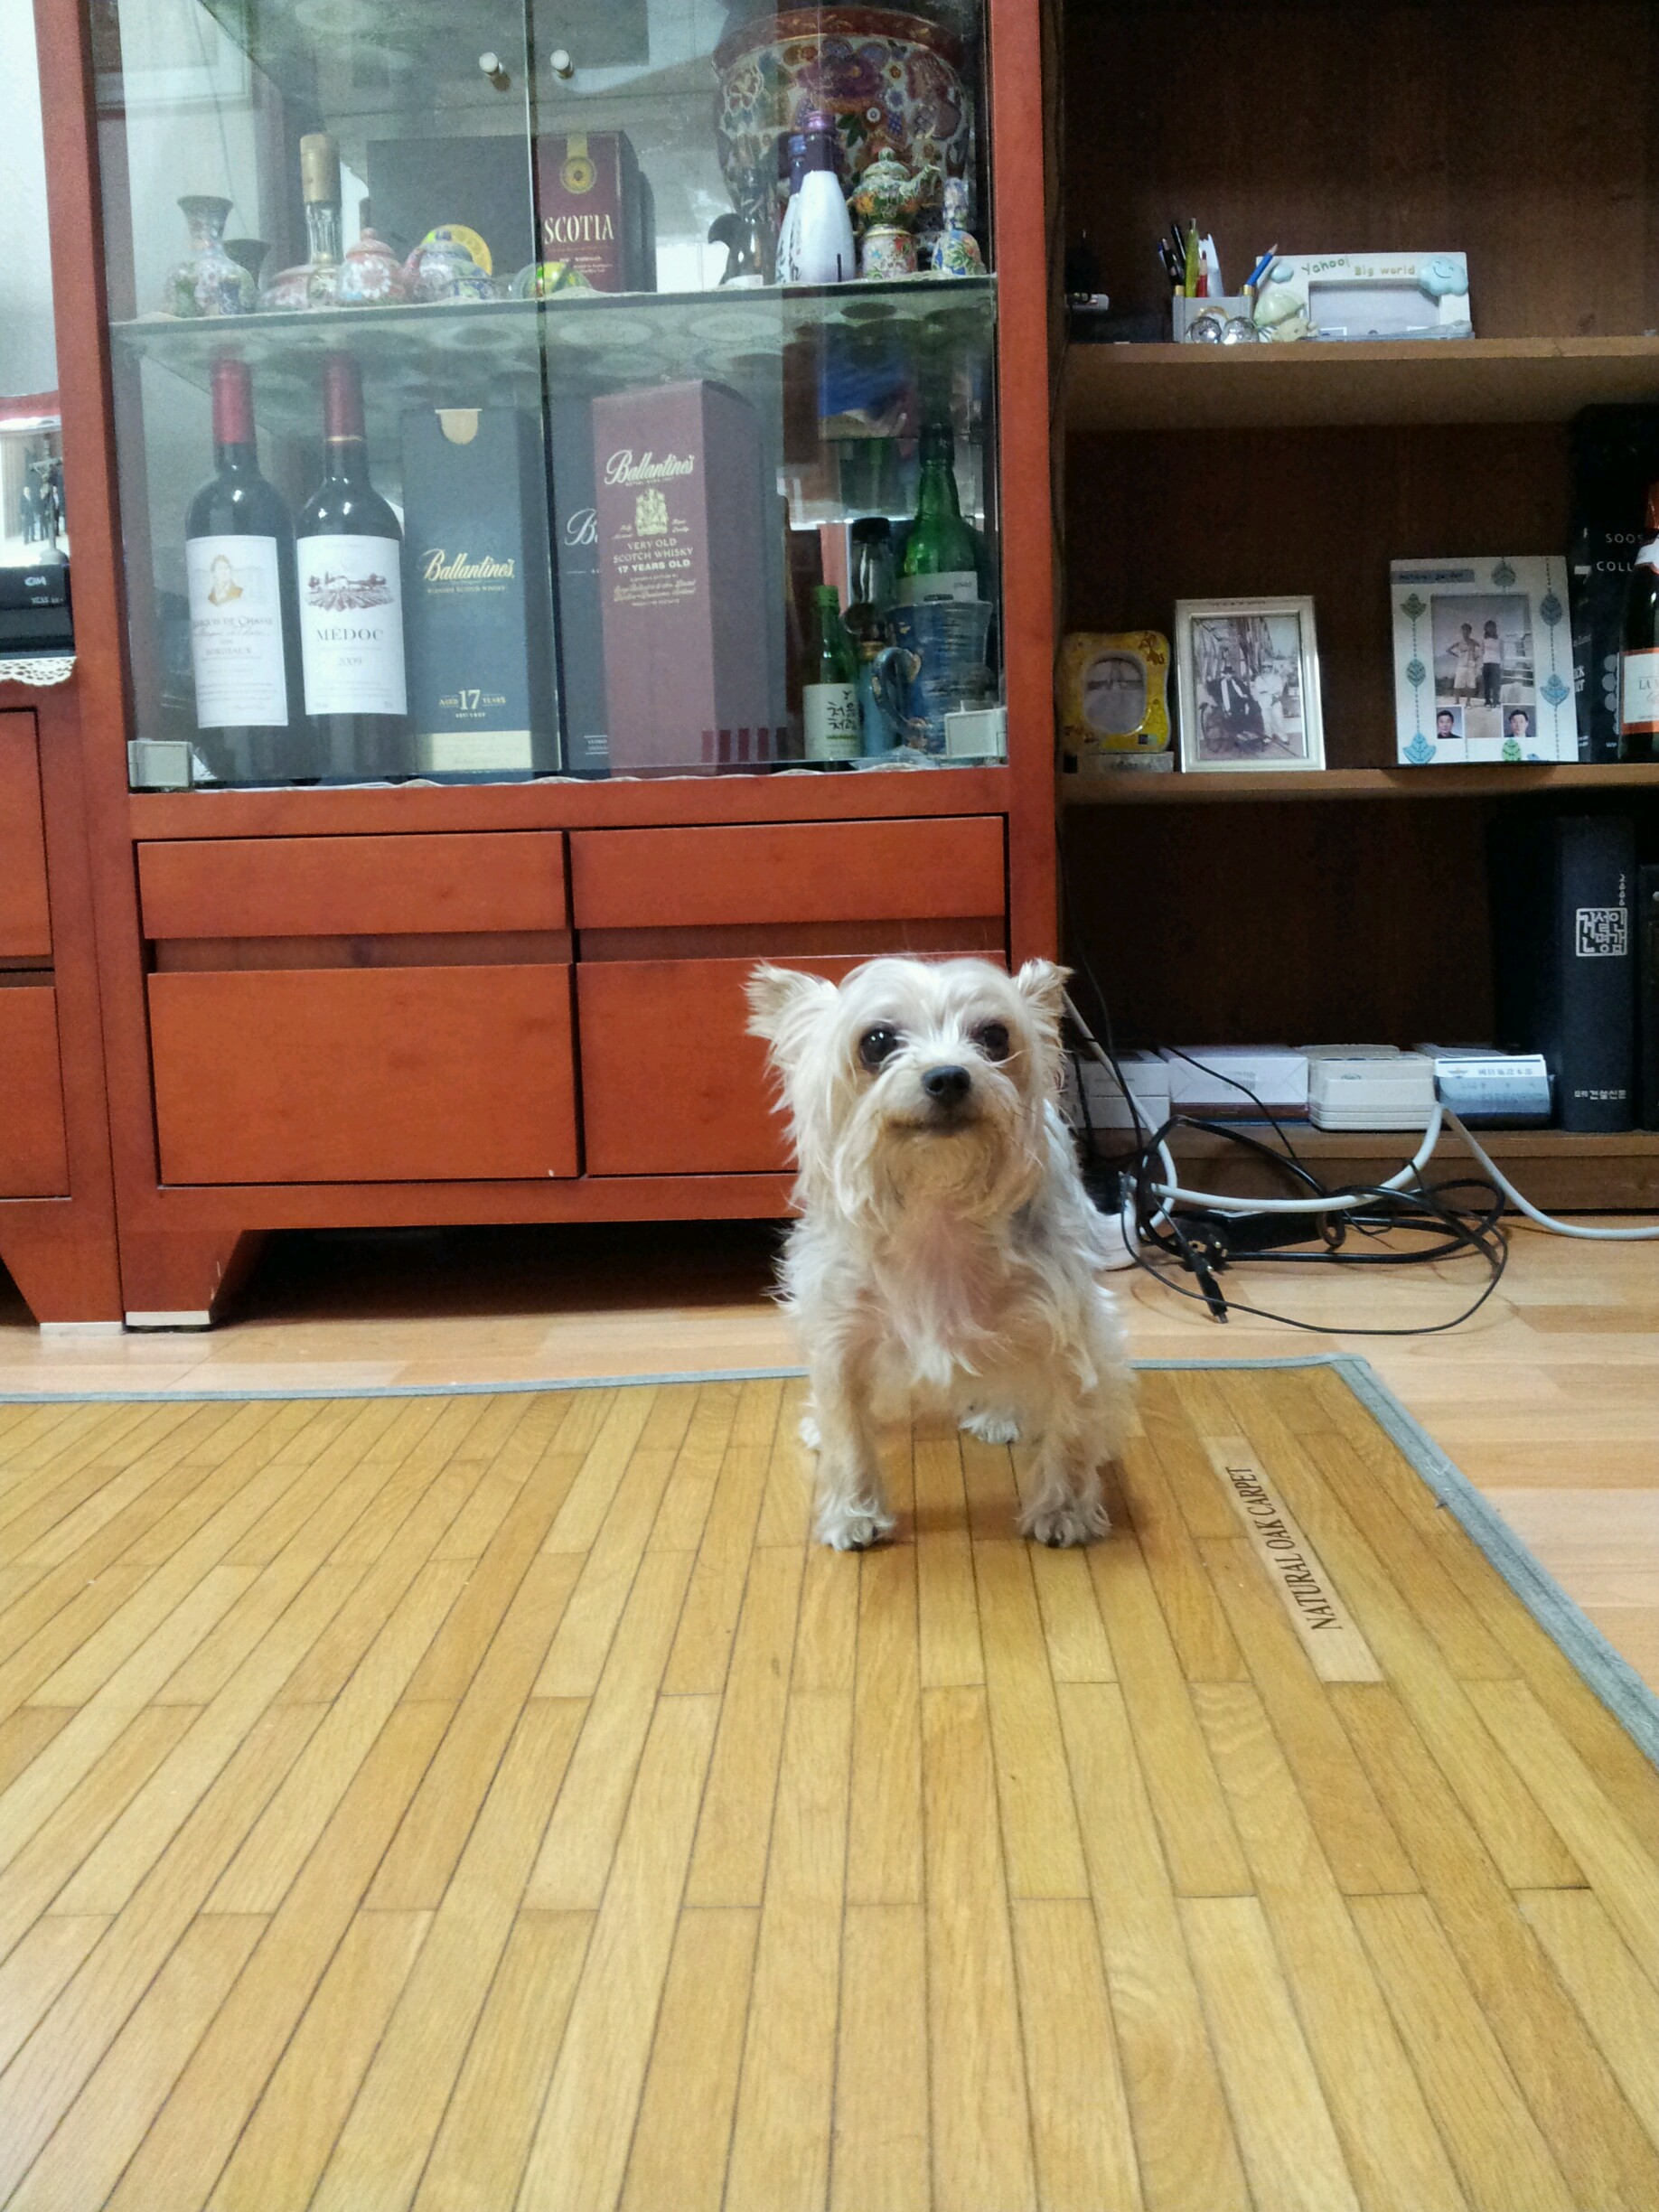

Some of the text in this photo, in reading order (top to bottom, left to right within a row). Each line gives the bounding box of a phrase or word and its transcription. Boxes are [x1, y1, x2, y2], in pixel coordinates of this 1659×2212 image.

[544, 214, 614, 245] SCOTIA
[1354, 265, 1374, 276] Big
[1381, 265, 1415, 276] world
[605, 449, 695, 485] Ballantine's
[627, 538, 677, 550] VERY OLD
[422, 548, 515, 581] Ballantine's
[613, 547, 694, 564] SCOTCH WHISKY
[617, 558, 690, 575] 17 YEARS OLD
[458, 689, 481, 710] 17
[1224, 1466, 1345, 1631] NATURAL OAK CARPET
